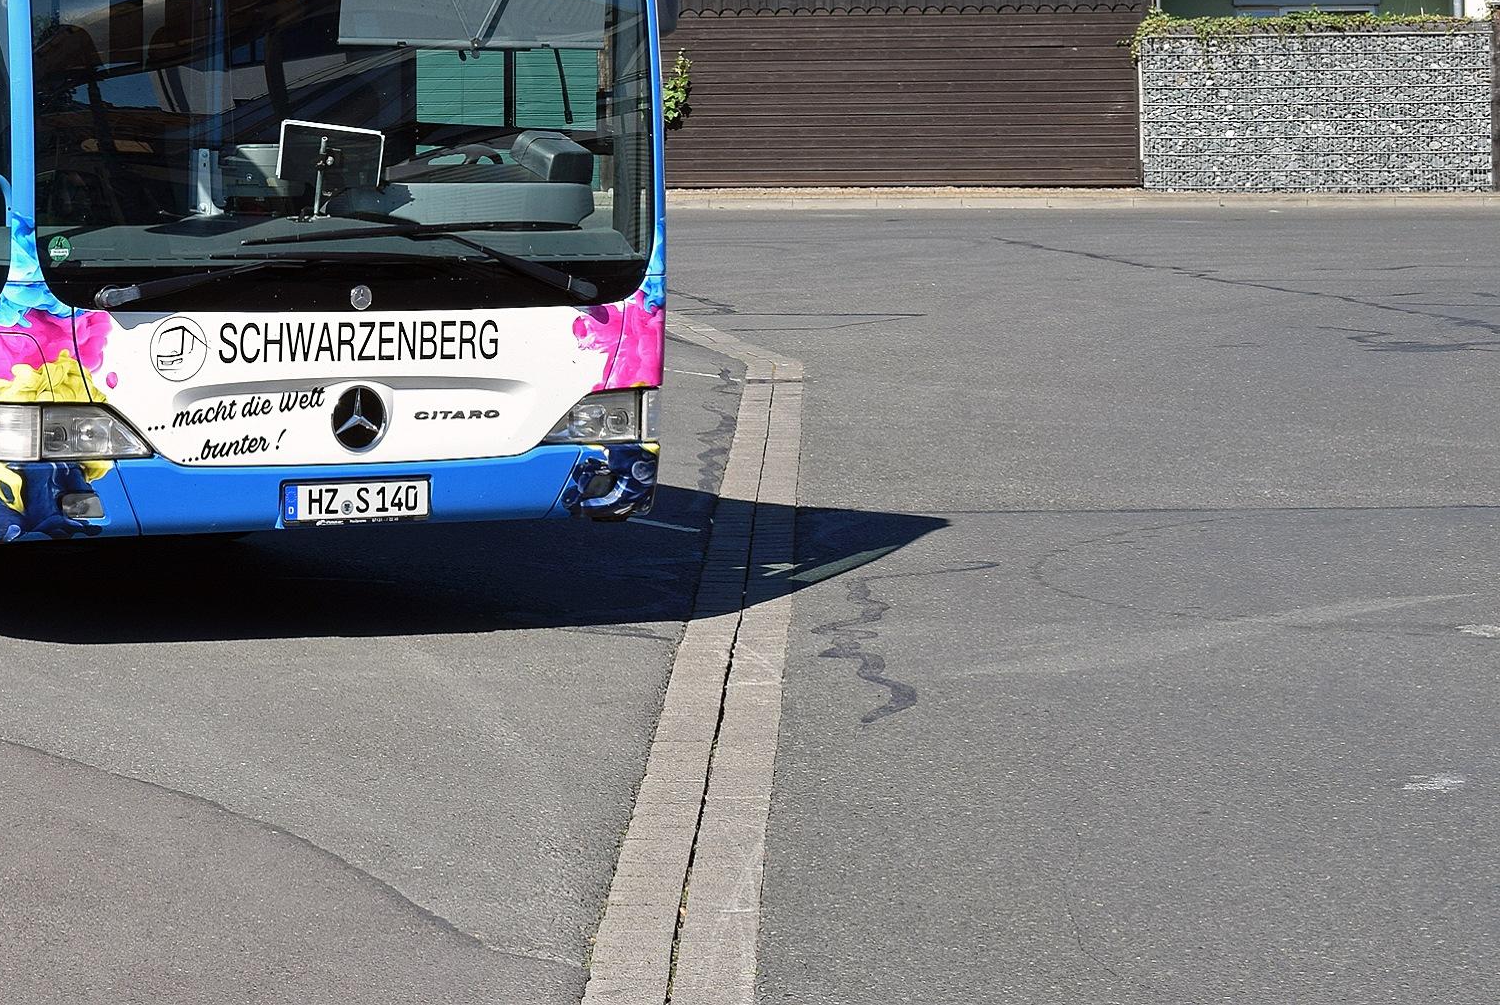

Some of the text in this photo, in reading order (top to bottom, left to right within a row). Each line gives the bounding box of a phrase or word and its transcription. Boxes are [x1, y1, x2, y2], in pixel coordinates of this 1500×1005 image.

[218, 320, 499, 364] SCHWARZENBERG
[172, 400, 236, 428] macht
[241, 396, 273, 418] die
[278, 386, 326, 413] Welt
[414, 410, 500, 421] CITARO
[308, 488, 339, 515] HZ
